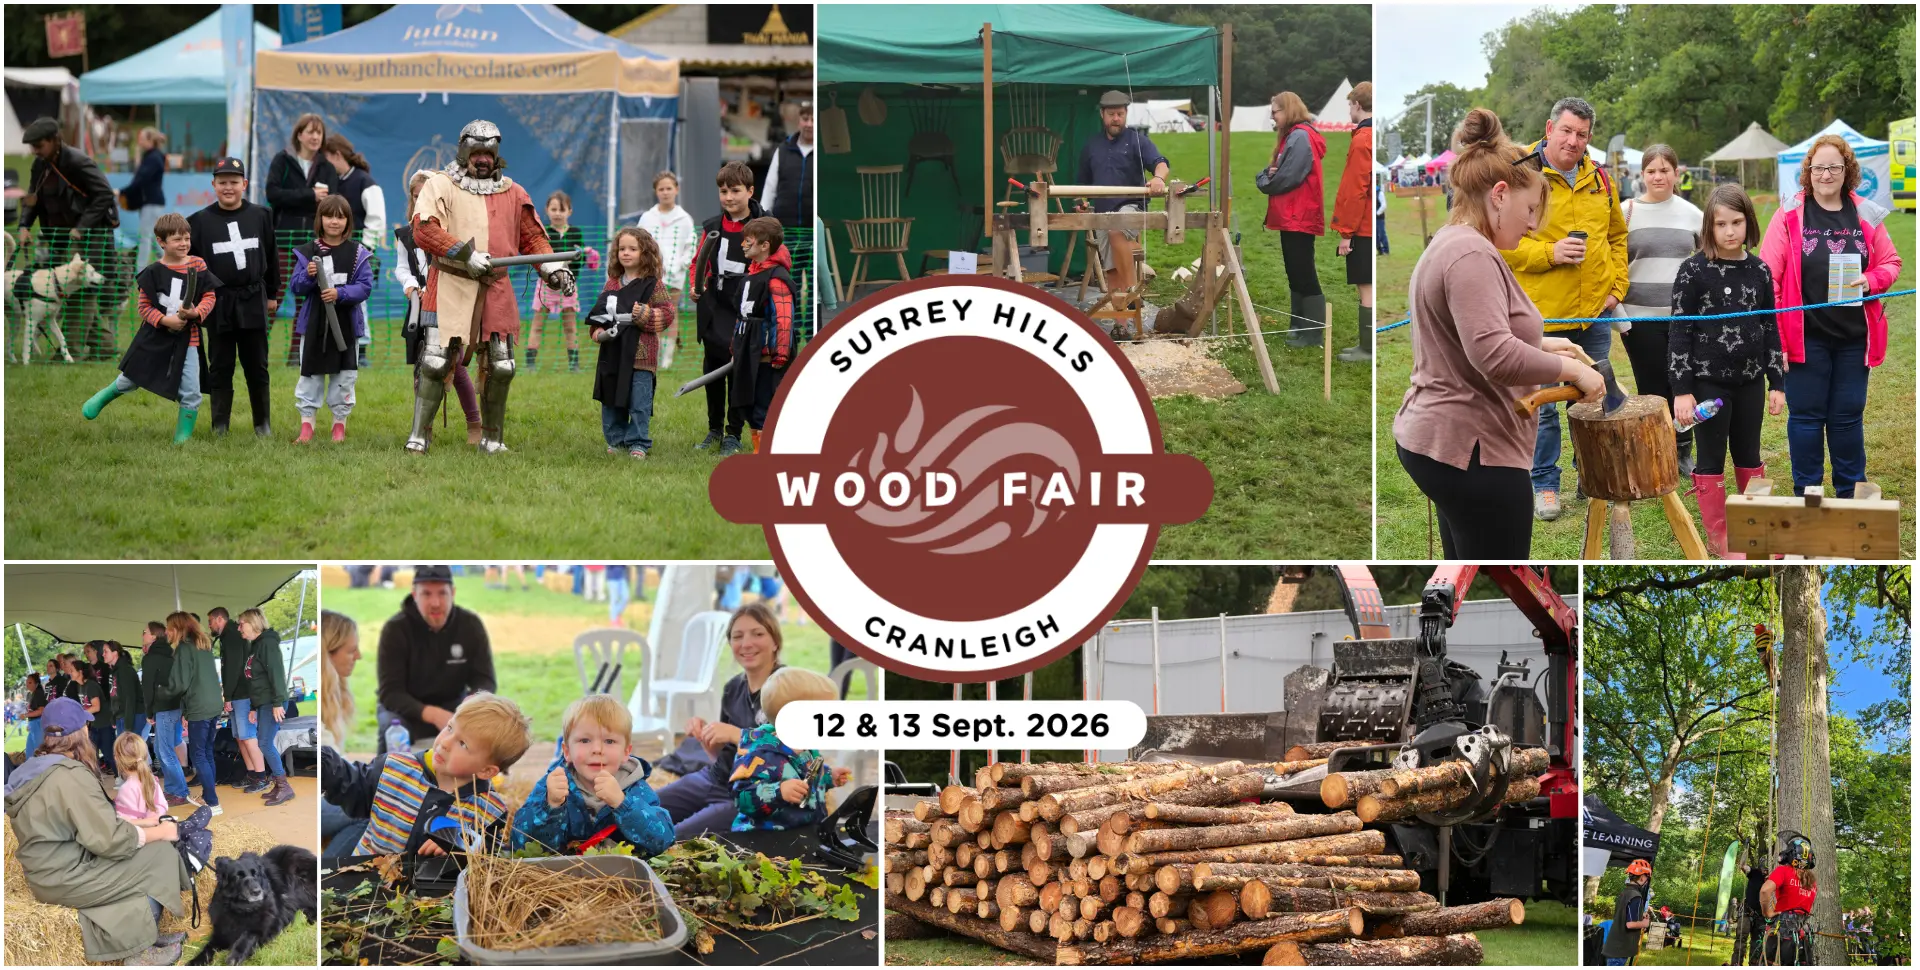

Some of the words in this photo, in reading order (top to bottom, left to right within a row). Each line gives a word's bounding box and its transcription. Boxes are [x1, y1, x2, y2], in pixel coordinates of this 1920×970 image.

[402, 22, 498, 42] juthan
[296, 57, 578, 82] www.juthanchocolate.com
[1592, 831, 1653, 848] LEARNING
